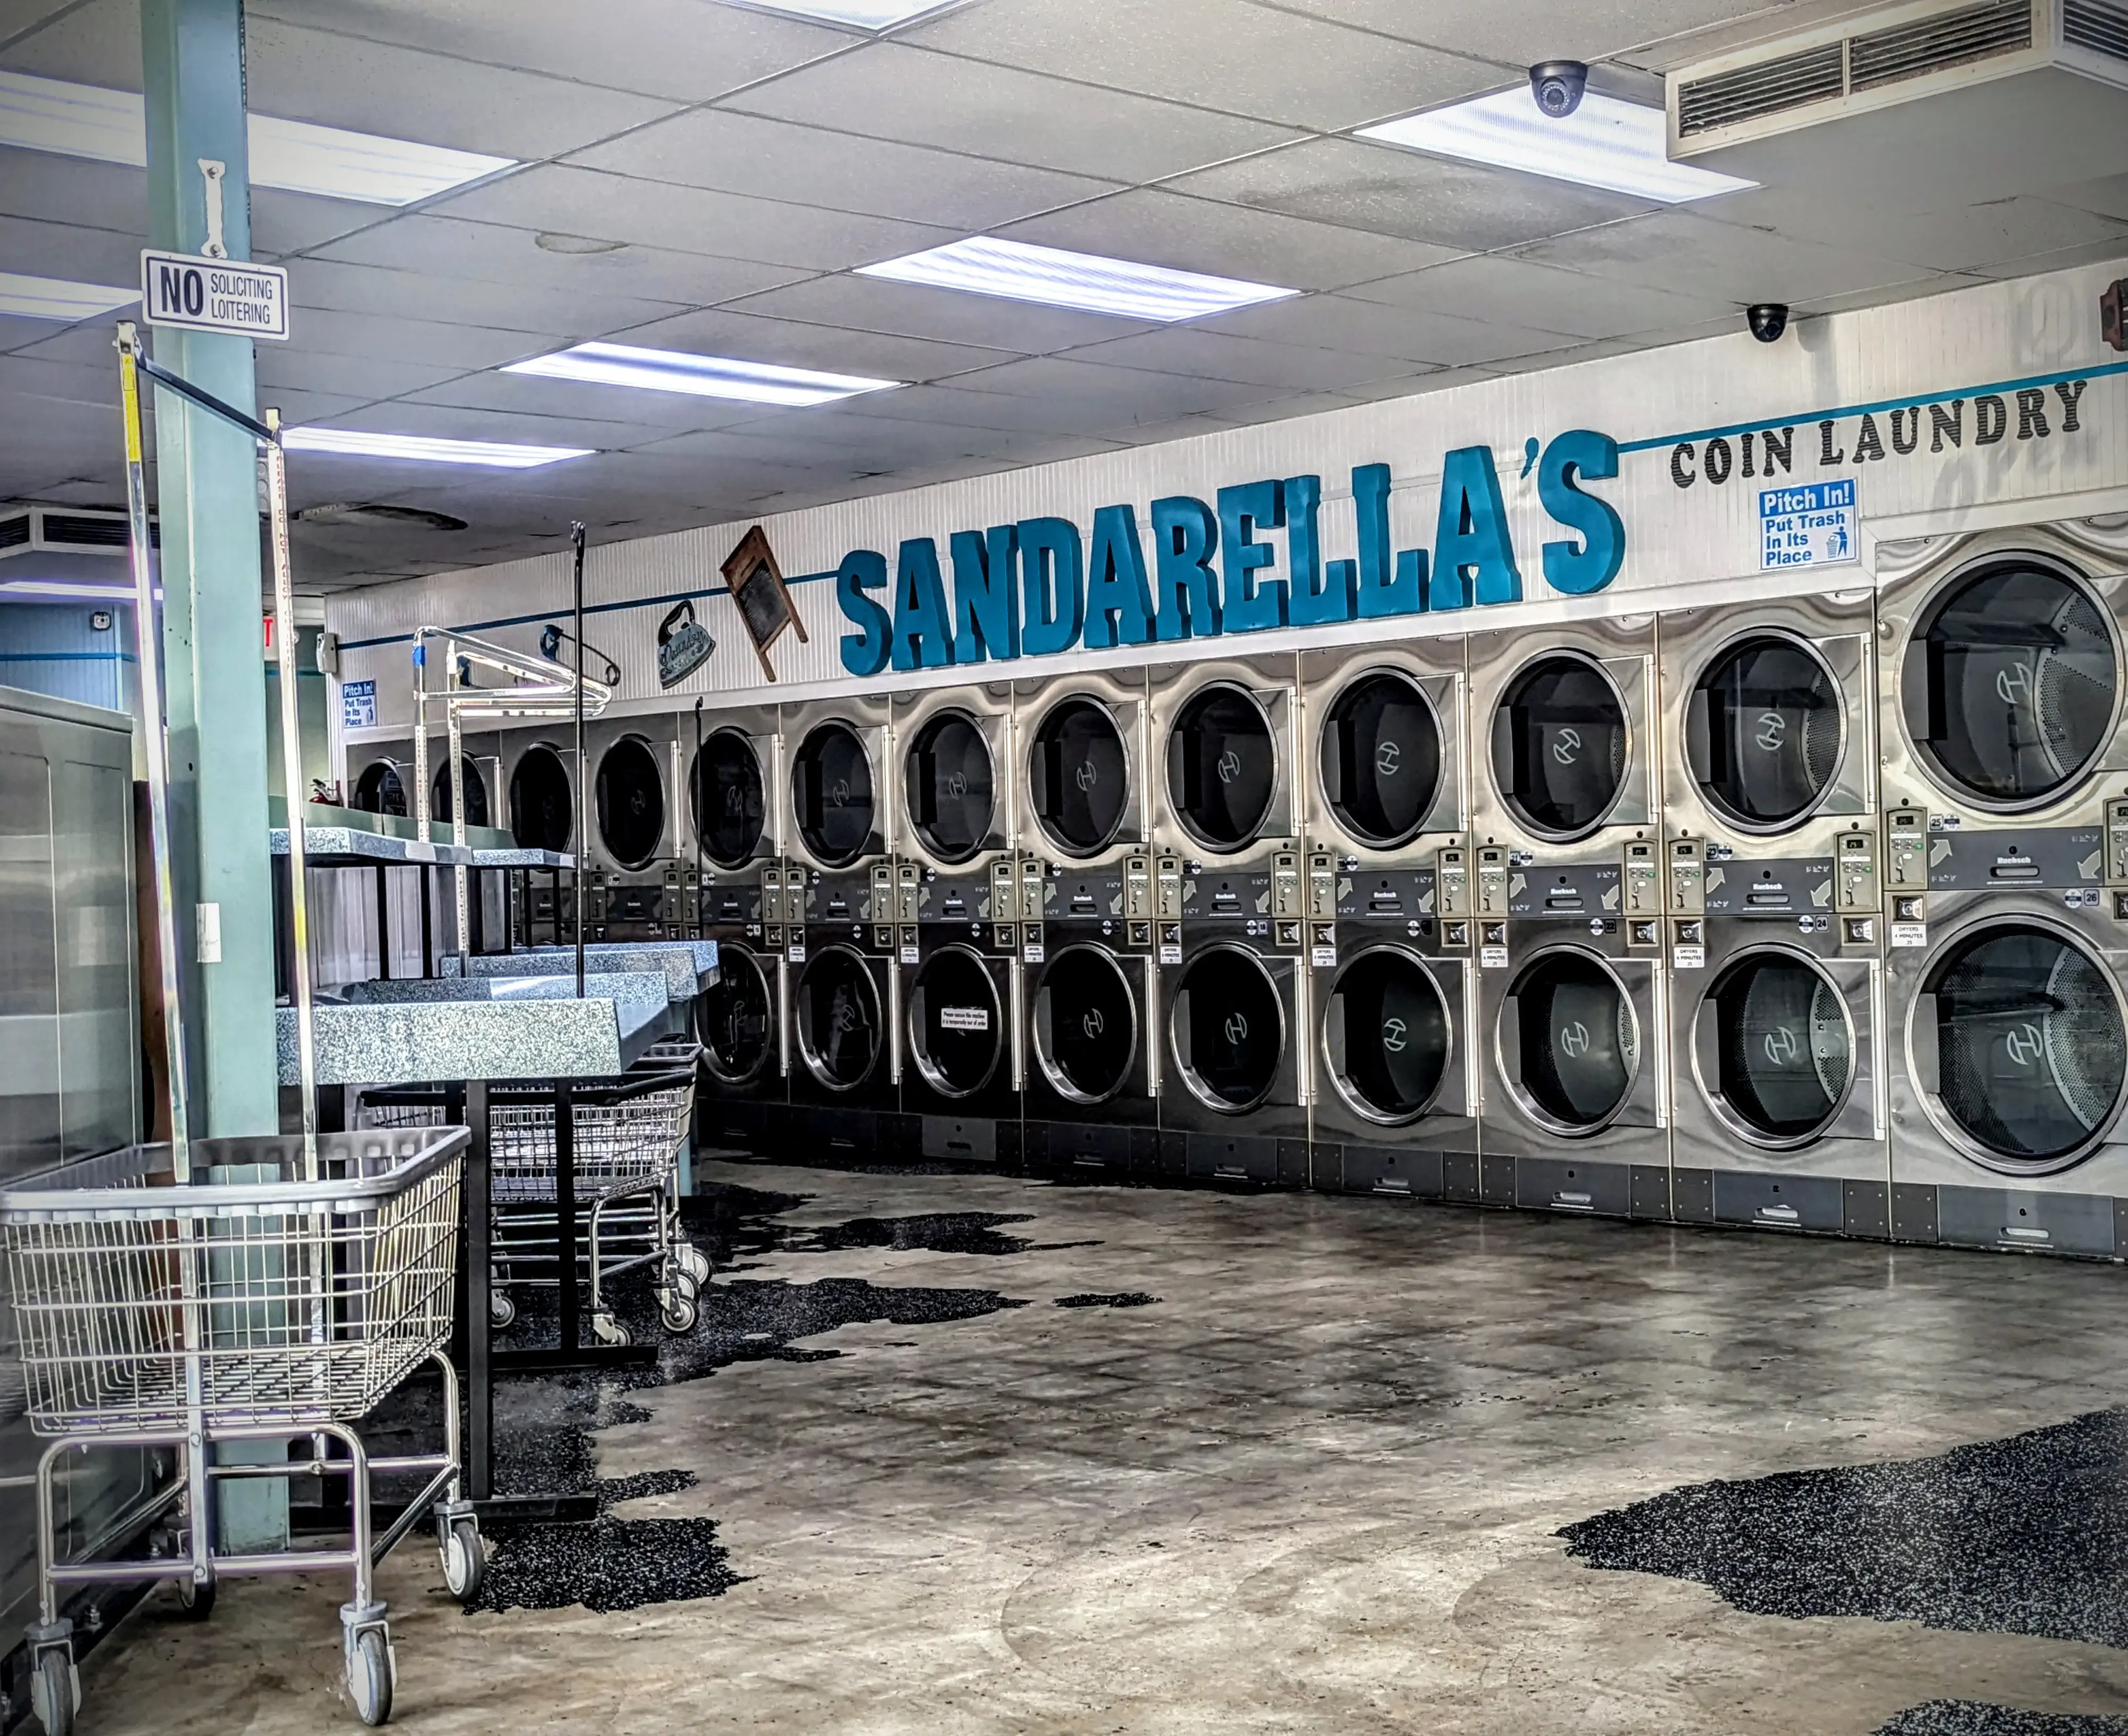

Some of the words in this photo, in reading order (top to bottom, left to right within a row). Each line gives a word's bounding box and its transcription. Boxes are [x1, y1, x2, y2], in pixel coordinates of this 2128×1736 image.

[161, 266, 204, 316] NO
[211, 272, 272, 300] SOLICITING
[211, 298, 270, 325] LOITERING
[1671, 426, 1794, 488] COIN
[1819, 380, 2088, 466] LAUNDRY
[1764, 488, 1816, 514] Pitch
[1823, 483, 1849, 506] In!
[1766, 517, 1793, 533] Put
[1798, 510, 1845, 529] Trash
[836, 429, 1625, 677] SANDARELLA'S
[1767, 535, 1781, 550] In
[1787, 533, 1808, 547] Its
[1766, 550, 1812, 566] Place
[344, 684, 362, 697] Pitch
[364, 682, 373, 695] In!
[345, 699, 354, 708] Put
[356, 697, 372, 707] Trash
[2086, 893, 2097, 902] 26
